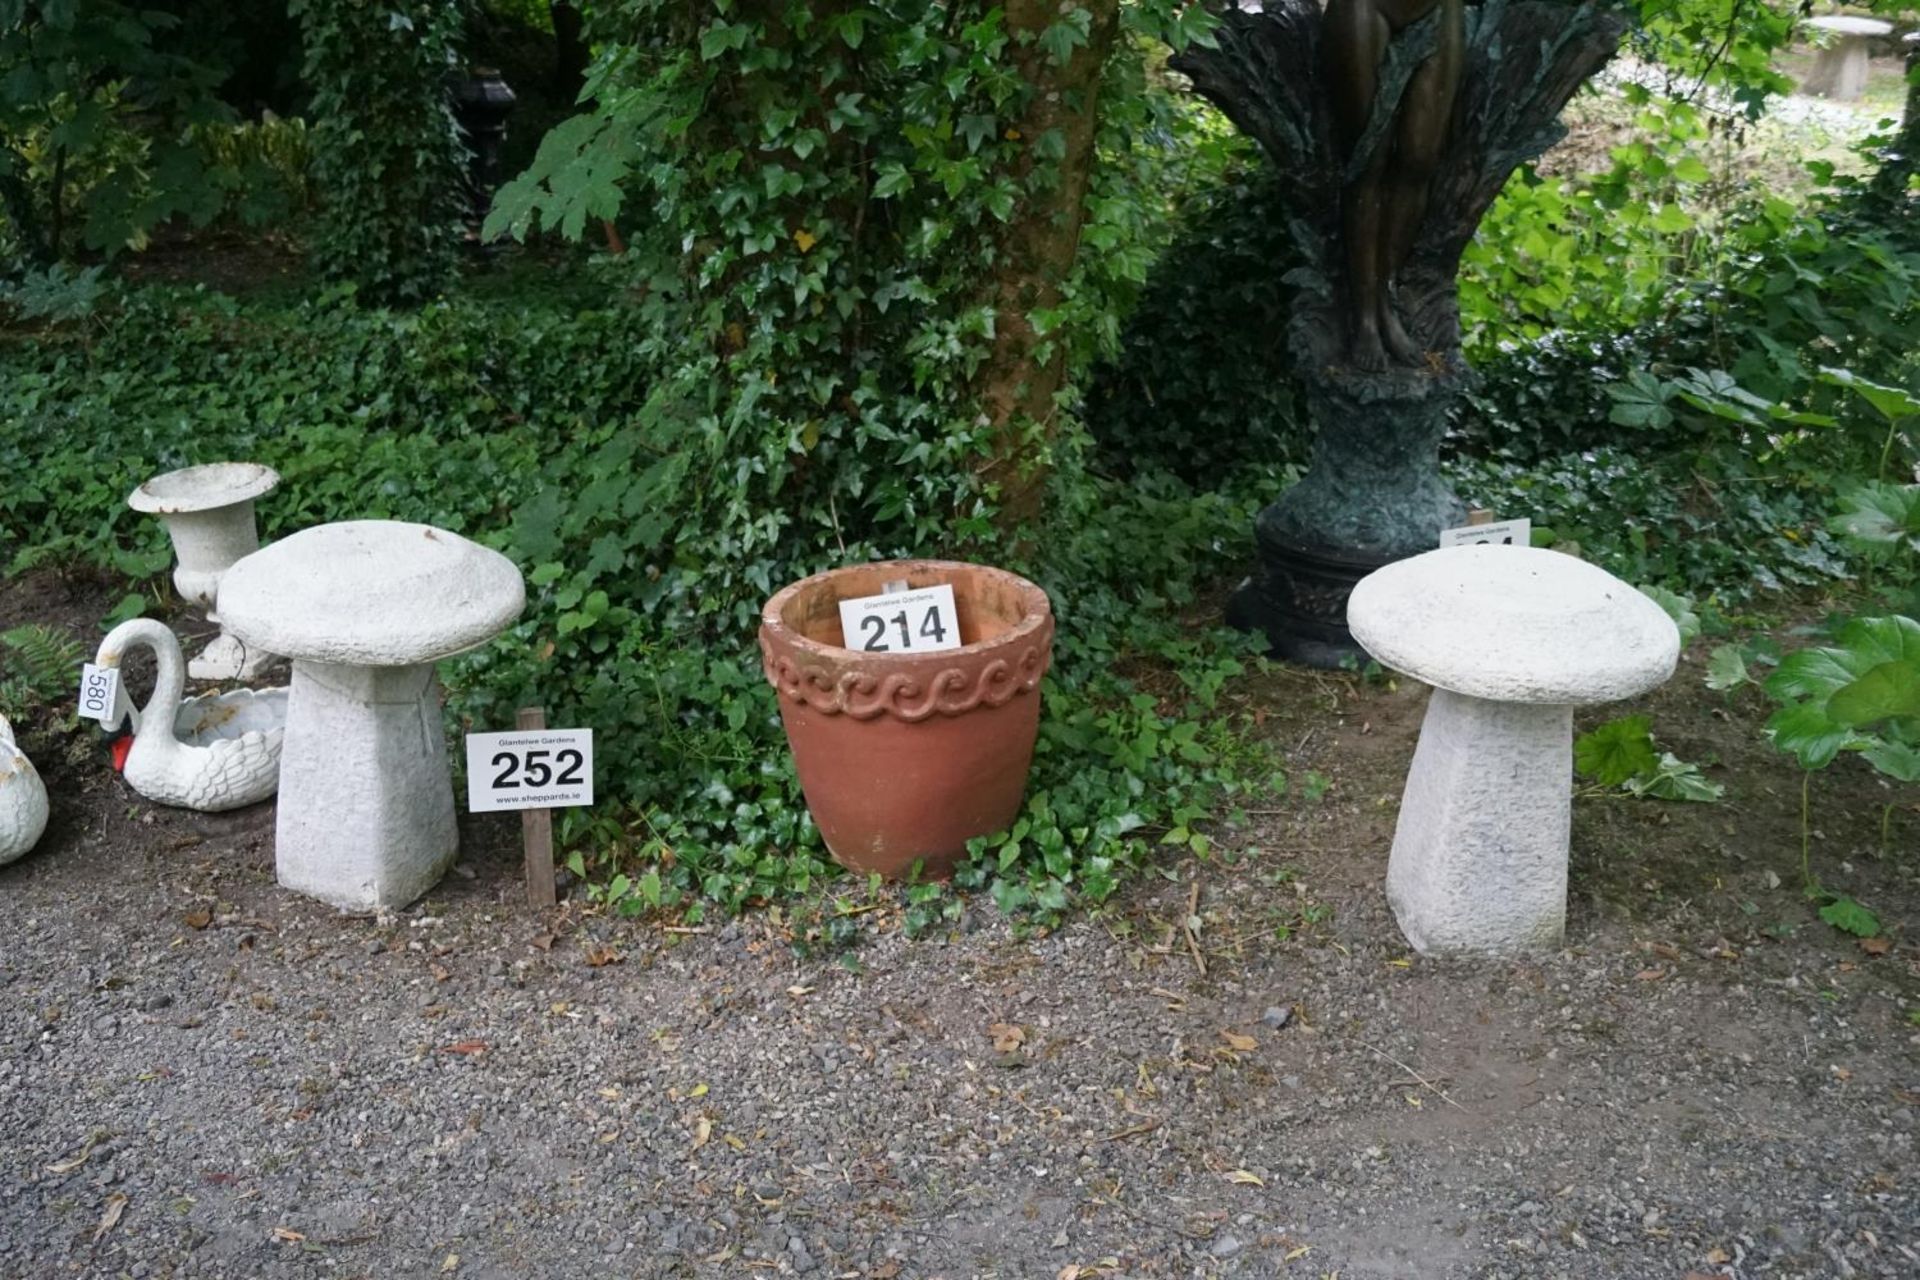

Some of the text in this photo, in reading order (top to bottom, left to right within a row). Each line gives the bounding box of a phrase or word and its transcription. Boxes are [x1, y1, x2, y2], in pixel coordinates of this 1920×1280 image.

[860, 605, 947, 652] 214
[86, 674, 107, 711] 580
[541, 736, 576, 744] Gardens
[491, 749, 584, 789] 252
[496, 792, 581, 804] www.sheppards.ie
